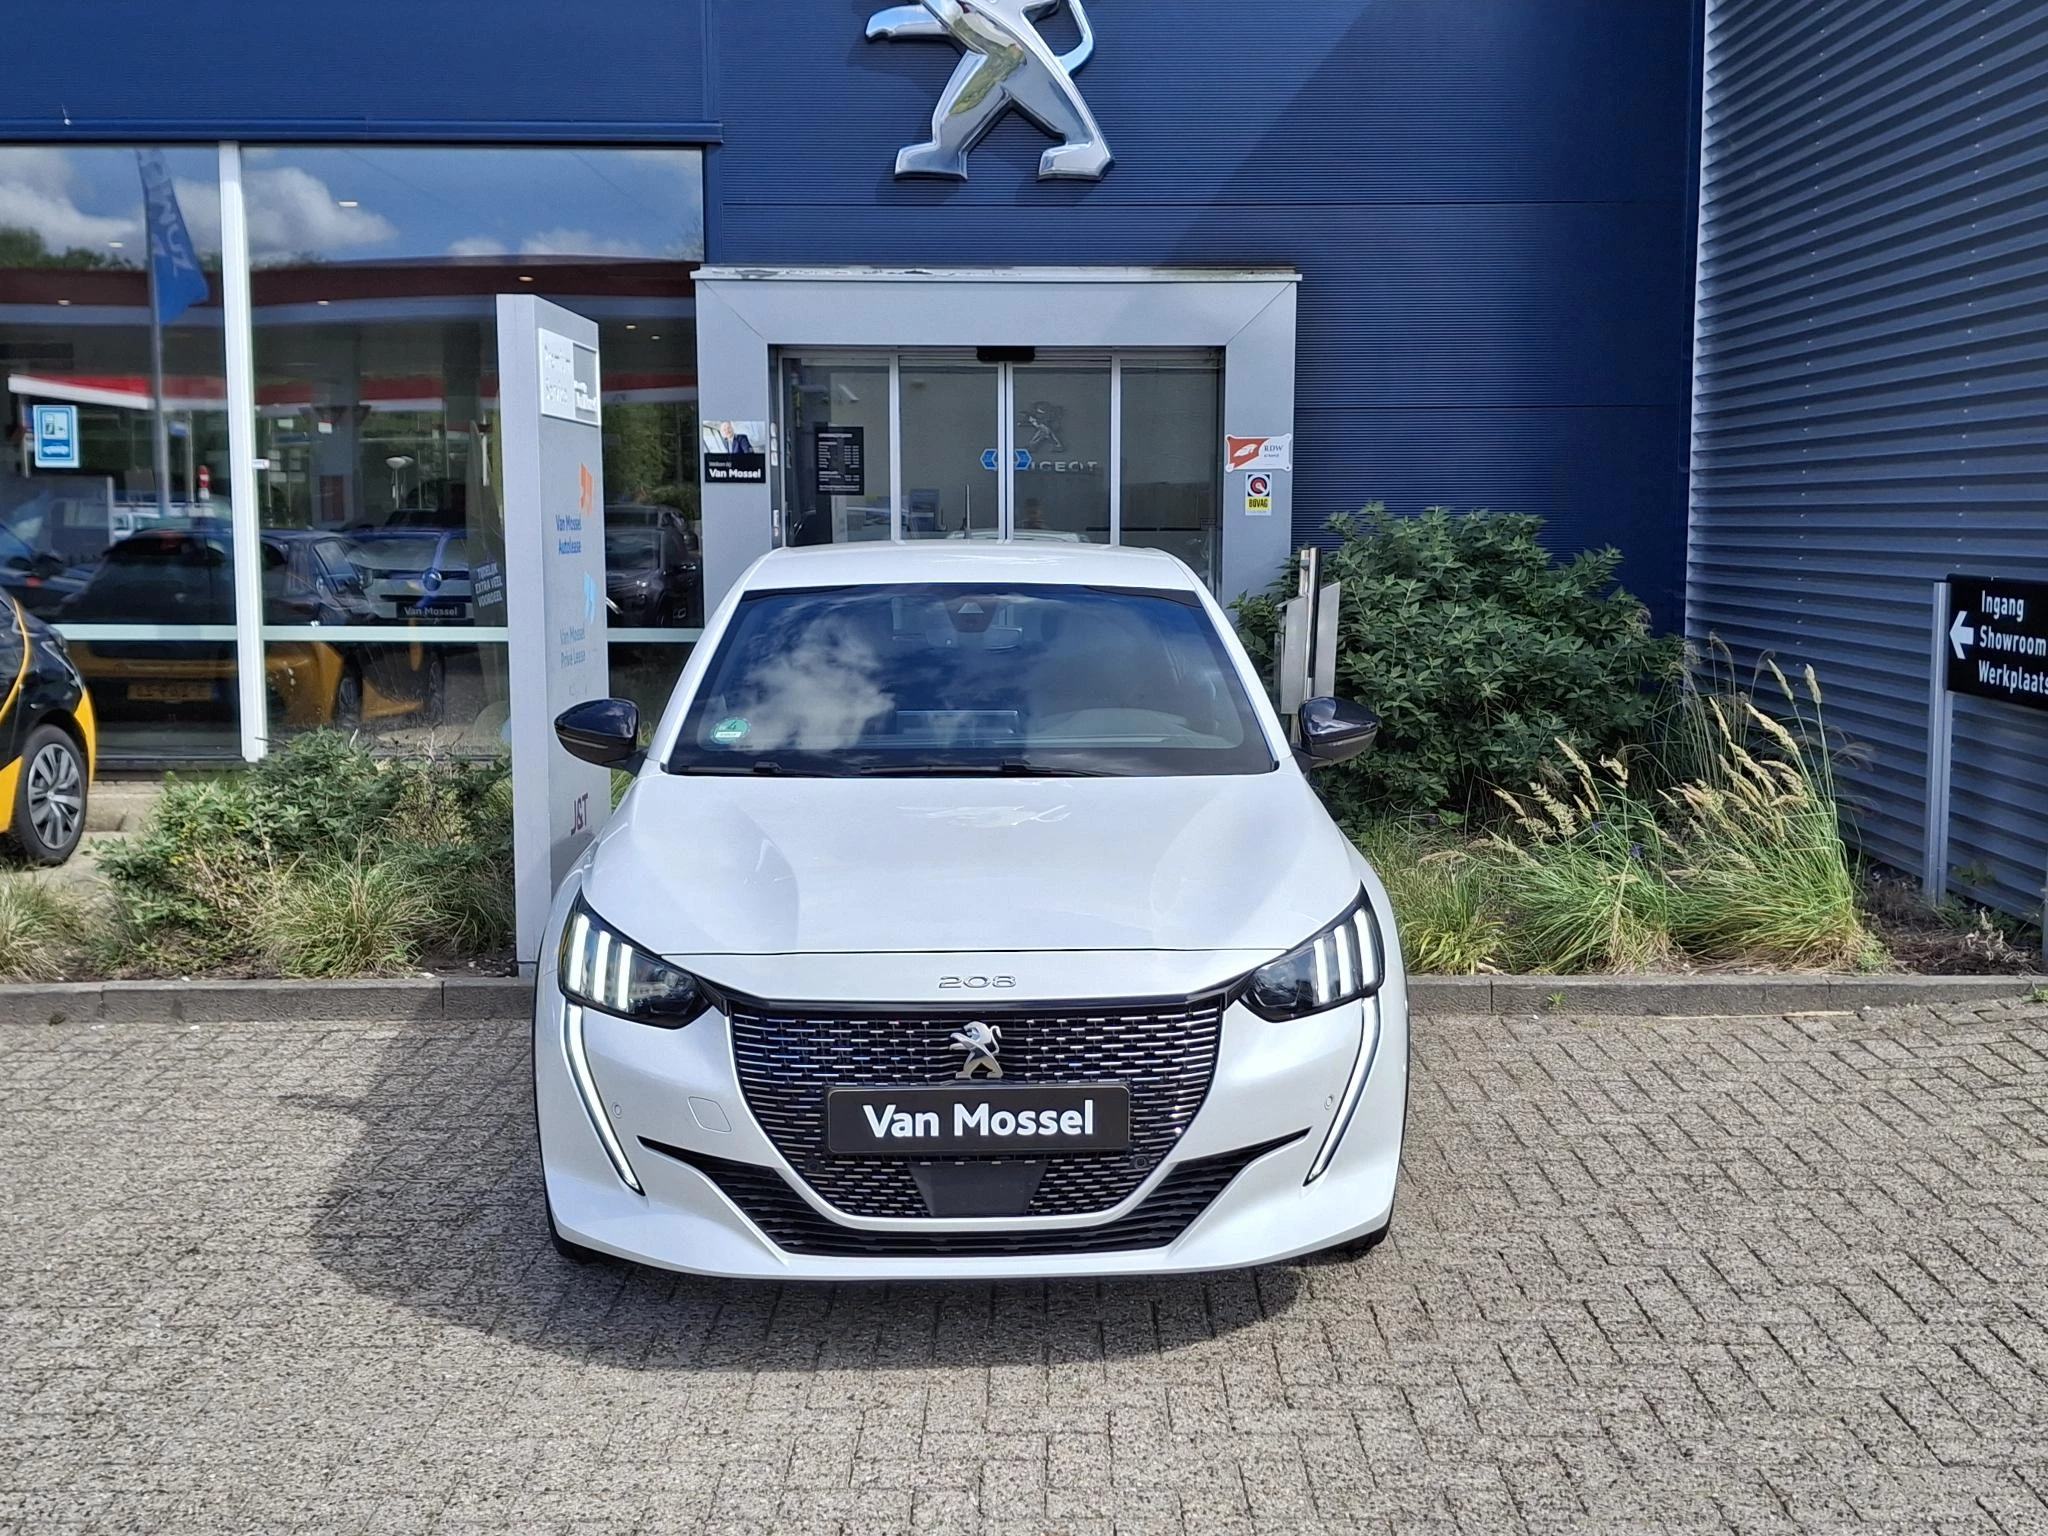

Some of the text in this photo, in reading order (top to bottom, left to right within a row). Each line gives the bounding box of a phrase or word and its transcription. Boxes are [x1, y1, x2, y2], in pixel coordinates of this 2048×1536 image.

[709, 469, 761, 478] Van Mossel
[1248, 499, 1268, 508] BOVAG
[555, 513, 581, 532] Van Mossel
[558, 537, 581, 555] Autolease
[404, 606, 458, 617] Van Mossel
[1981, 589, 2024, 622] Ingang
[1979, 625, 2047, 656] Showroom
[570, 792, 589, 837] J&T
[937, 975, 1017, 989] 208
[862, 1100, 1094, 1138] Van Mossel
